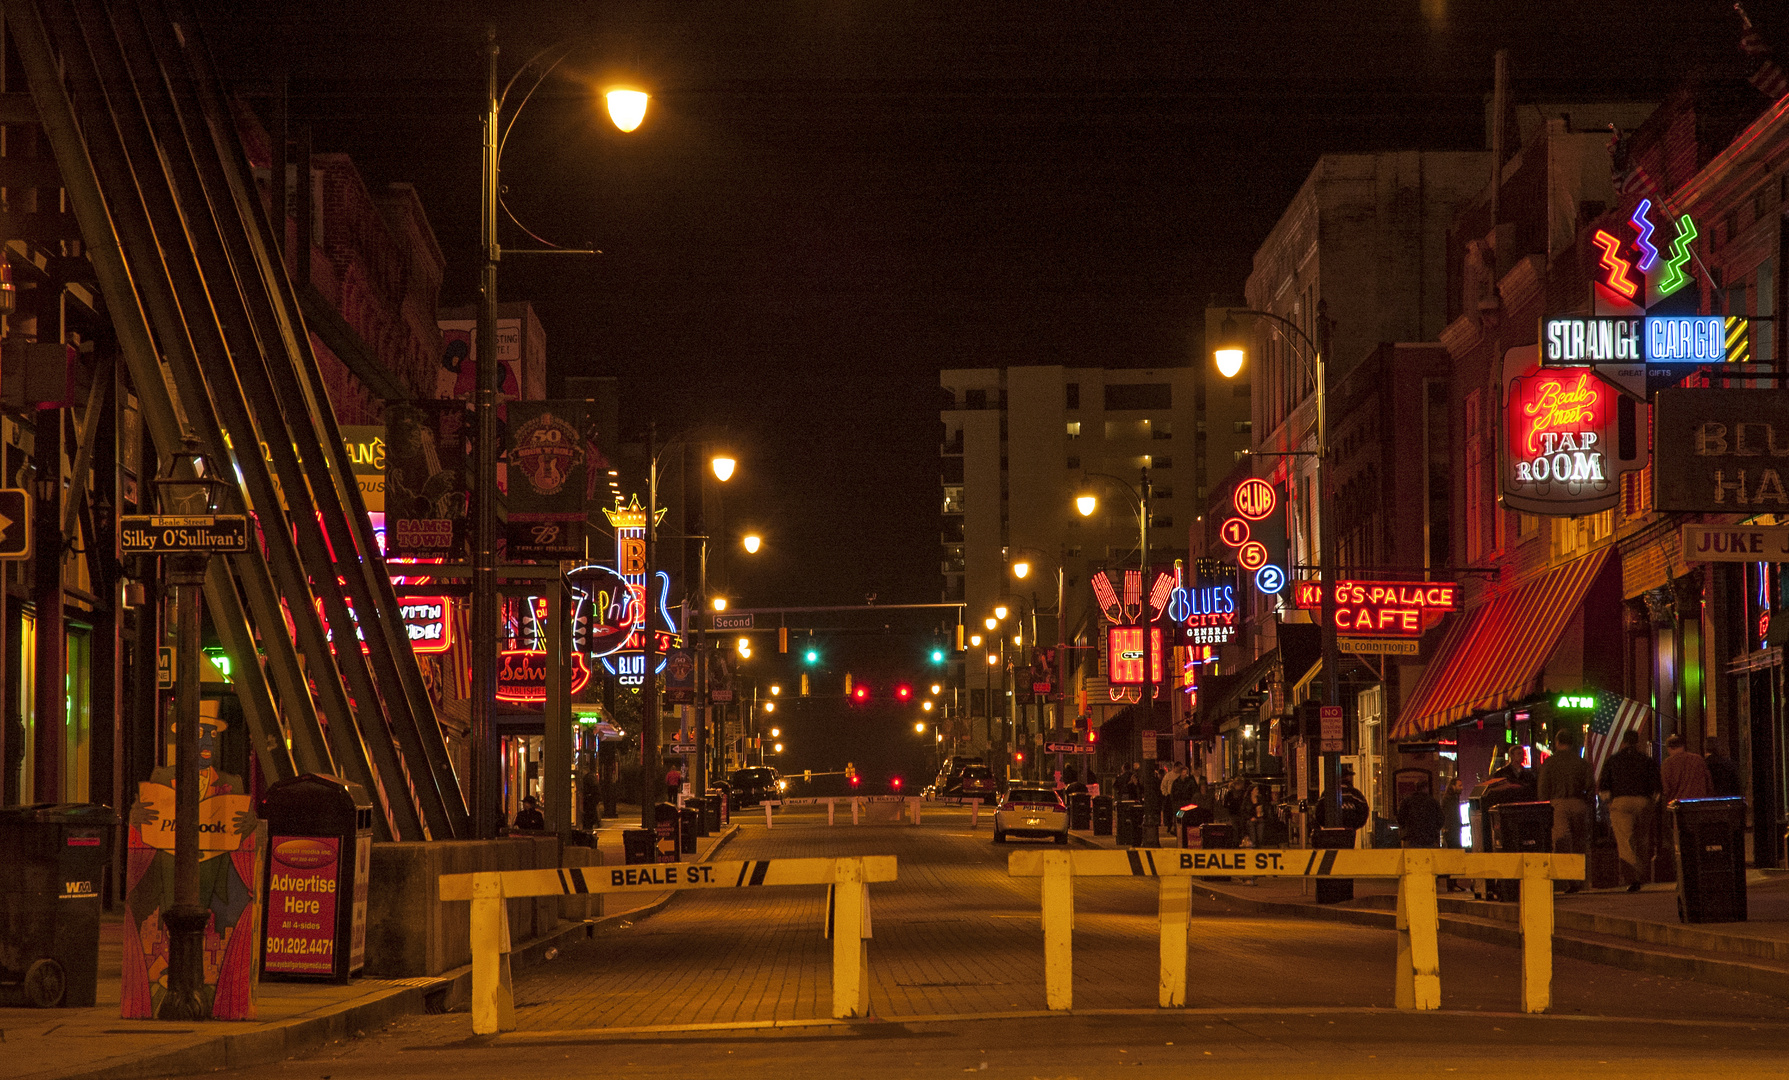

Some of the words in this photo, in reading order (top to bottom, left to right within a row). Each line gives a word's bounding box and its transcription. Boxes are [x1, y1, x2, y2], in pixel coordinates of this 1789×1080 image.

[496, 334, 518, 344] STING
[1548, 320, 1640, 360] STRANGE
[1651, 320, 1720, 359] CARGO
[1527, 374, 1597, 413] Beale
[532, 429, 562, 442] 50
[1529, 405, 1594, 451] Street
[1540, 432, 1597, 456] TAP
[1515, 452, 1604, 481] ROOM
[1239, 483, 1272, 515] CLUB
[123, 529, 157, 549] Silky
[163, 529, 244, 546] O'Sullivan's
[398, 533, 453, 547] TOWN
[1230, 523, 1240, 541] 1
[1697, 533, 1764, 553] JUKE
[1246, 546, 1260, 565] 5
[1263, 570, 1278, 588] 2
[1177, 585, 1235, 622] BLUES
[1302, 583, 1365, 604] KIG'S
[1371, 587, 1453, 606] PALACE
[716, 617, 750, 627] Second
[1187, 613, 1235, 627] CITY
[1335, 609, 1419, 630] CAFE
[1114, 630, 1159, 650] BLUS
[1187, 626, 1235, 637] GENERAL
[1195, 635, 1227, 644] STORE
[1355, 643, 1416, 652] CONDITIONED
[1114, 653, 1159, 680] CAE
[1557, 697, 1594, 708] ATM
[160, 820, 226, 833] Plook
[278, 848, 300, 856] eyeball
[1180, 854, 1246, 869] BEALE
[1255, 854, 1284, 869] ST.
[270, 874, 336, 893] Advertise
[611, 867, 677, 885] BEALE
[687, 866, 715, 883] ST.
[66, 881, 92, 894] WM
[284, 896, 320, 915] Here
[282, 921, 291, 929] All
[293, 921, 320, 930] 4-sides
[267, 937, 333, 955] 901.202.4471
